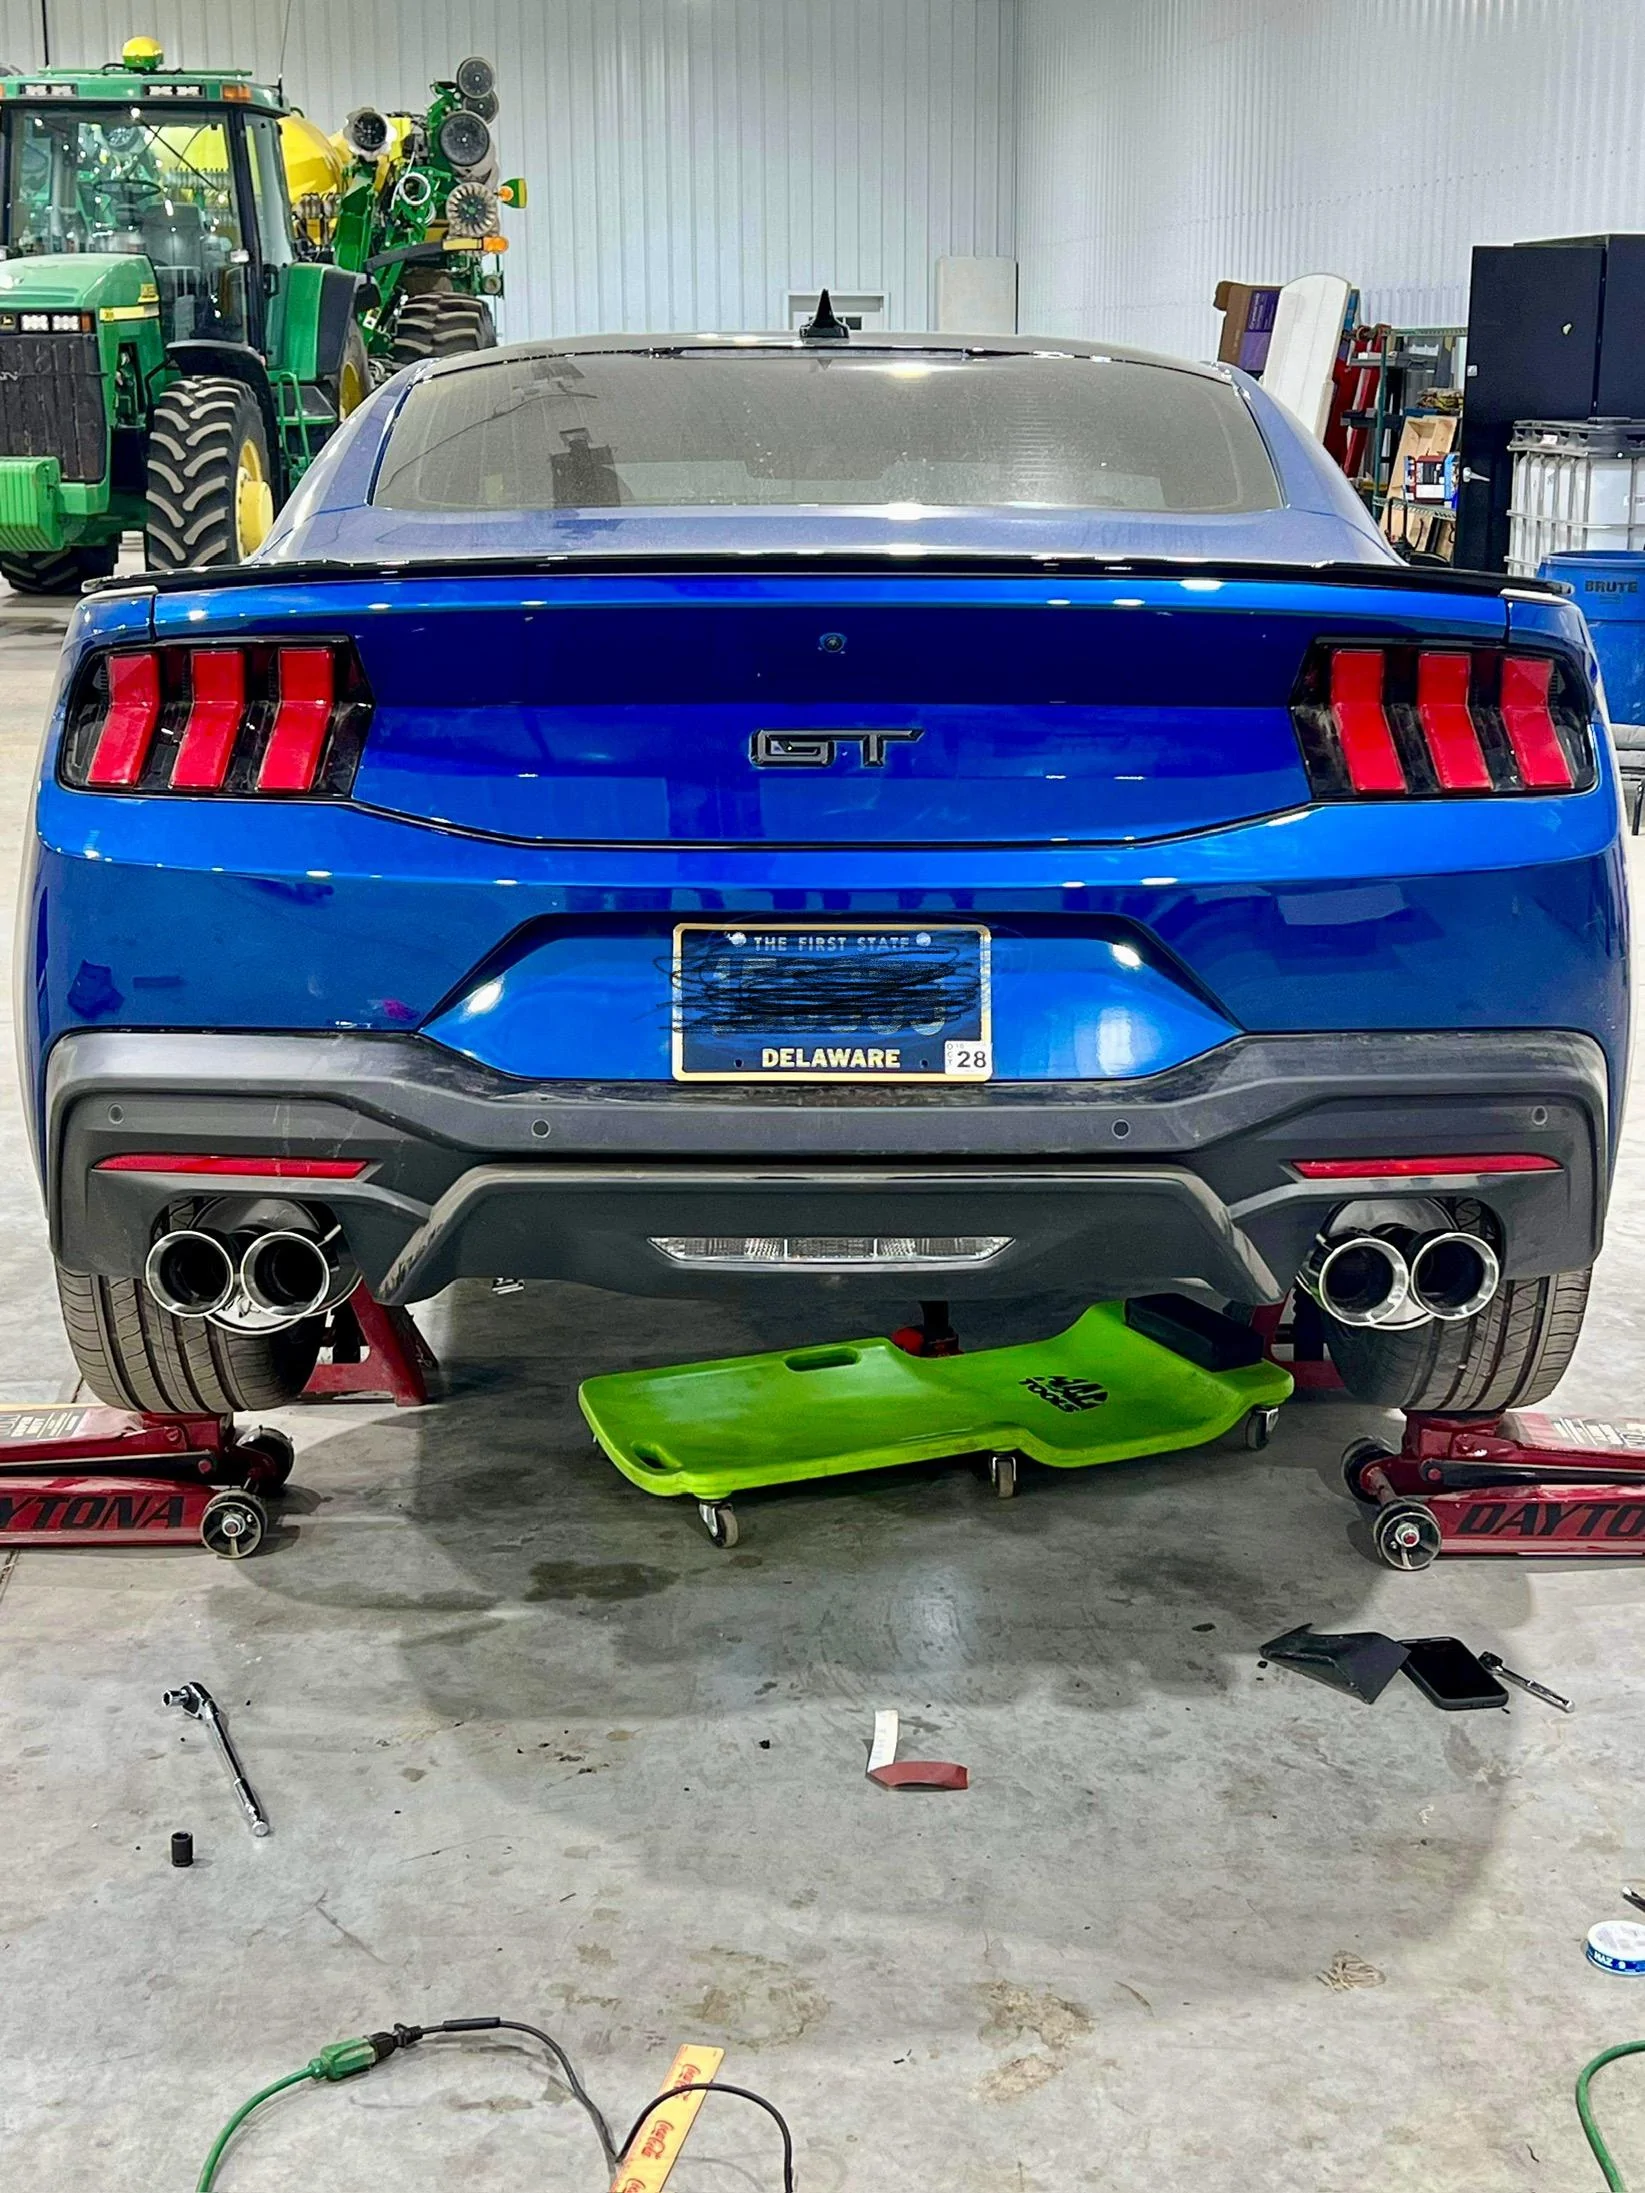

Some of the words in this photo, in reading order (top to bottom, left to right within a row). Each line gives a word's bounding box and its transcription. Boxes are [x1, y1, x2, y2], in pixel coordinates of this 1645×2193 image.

[1585, 580, 1637, 593] BRUTE
[749, 728, 925, 769] GT
[754, 937, 788, 951] THE
[799, 937, 847, 951] FIRST
[857, 937, 910, 951] STATE
[762, 1048, 901, 1069] DELAWARE
[957, 1050, 987, 1069] 28
[1456, 1503, 1645, 1536] DAYTO
